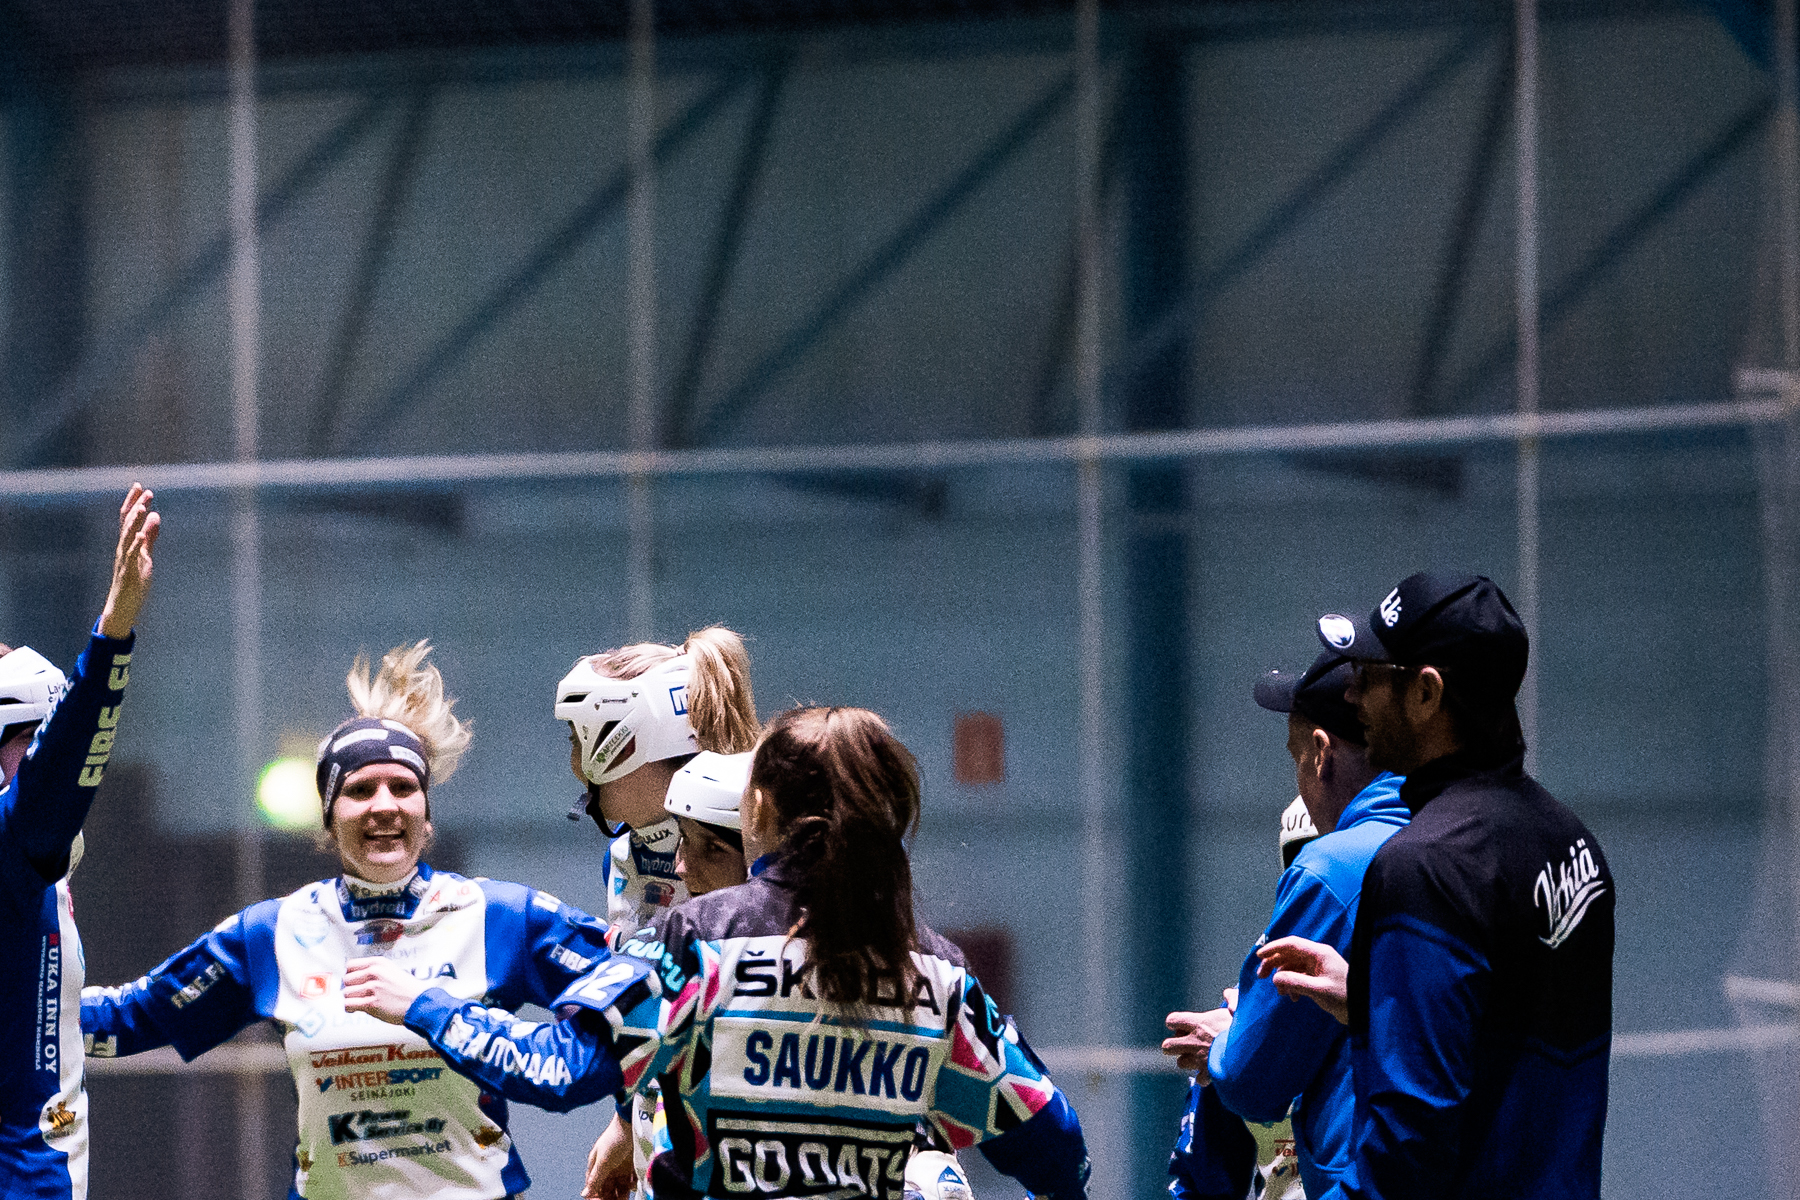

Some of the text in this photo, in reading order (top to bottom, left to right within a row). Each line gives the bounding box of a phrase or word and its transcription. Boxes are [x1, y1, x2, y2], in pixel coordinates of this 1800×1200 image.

[45, 998, 58, 1037] INN
[44, 1043, 57, 1074] OY
[743, 1030, 930, 1102] SAUKKO
[335, 1067, 444, 1090] INTERSPORT
[350, 1089, 415, 1101] SEINÄJOKI
[350, 1139, 452, 1166] Supermarket
[718, 1137, 791, 1193] GO
